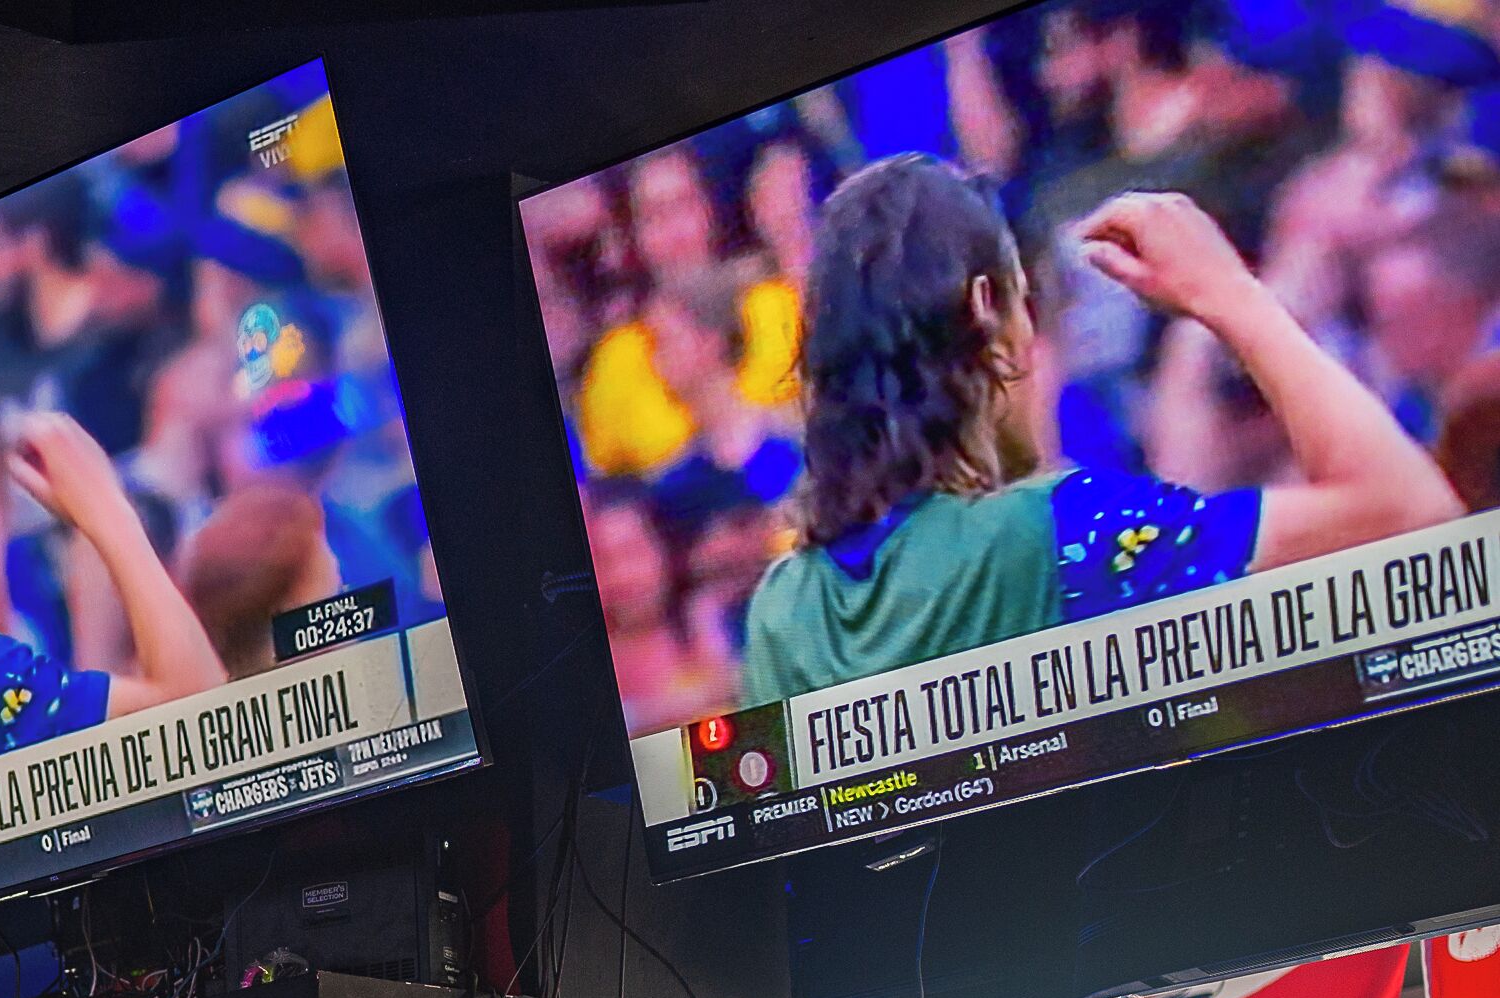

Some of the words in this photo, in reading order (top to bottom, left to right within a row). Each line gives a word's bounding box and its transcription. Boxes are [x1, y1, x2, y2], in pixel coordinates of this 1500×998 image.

[248, 114, 300, 152] ESPN
[294, 607, 375, 652] 00:24:37
[808, 689, 917, 775] FIESTA
[920, 661, 1026, 745] TOTAL
[1032, 646, 1077, 719] EN
[1083, 633, 1130, 705] LA
[1134, 599, 1264, 692] PREVIA
[1271, 581, 1320, 658] DE
[1326, 569, 1376, 644] LA
[1384, 537, 1491, 629] GRAN
[27, 740, 120, 822] PREVIA
[120, 728, 158, 794] DE
[159, 718, 197, 783] LA
[197, 692, 275, 772] GRAN
[276, 669, 360, 750] FINAL
[829, 769, 918, 806] Newcastle
[999, 731, 1068, 764] Arsenal
[1147, 707, 1164, 728] 0
[1176, 696, 1220, 721] Final
[214, 774, 290, 815] CHARGERS
[299, 761, 337, 792] JETS
[753, 795, 819, 824] PREMIER
[835, 805, 874, 829] NEW
[894, 790, 954, 815] Gordon
[41, 833, 52, 853] 0
[60, 825, 92, 848] Final
[667, 815, 736, 852] ESPN
[304, 884, 346, 898] MEMBER'S
[307, 892, 344, 904] SELECTION
